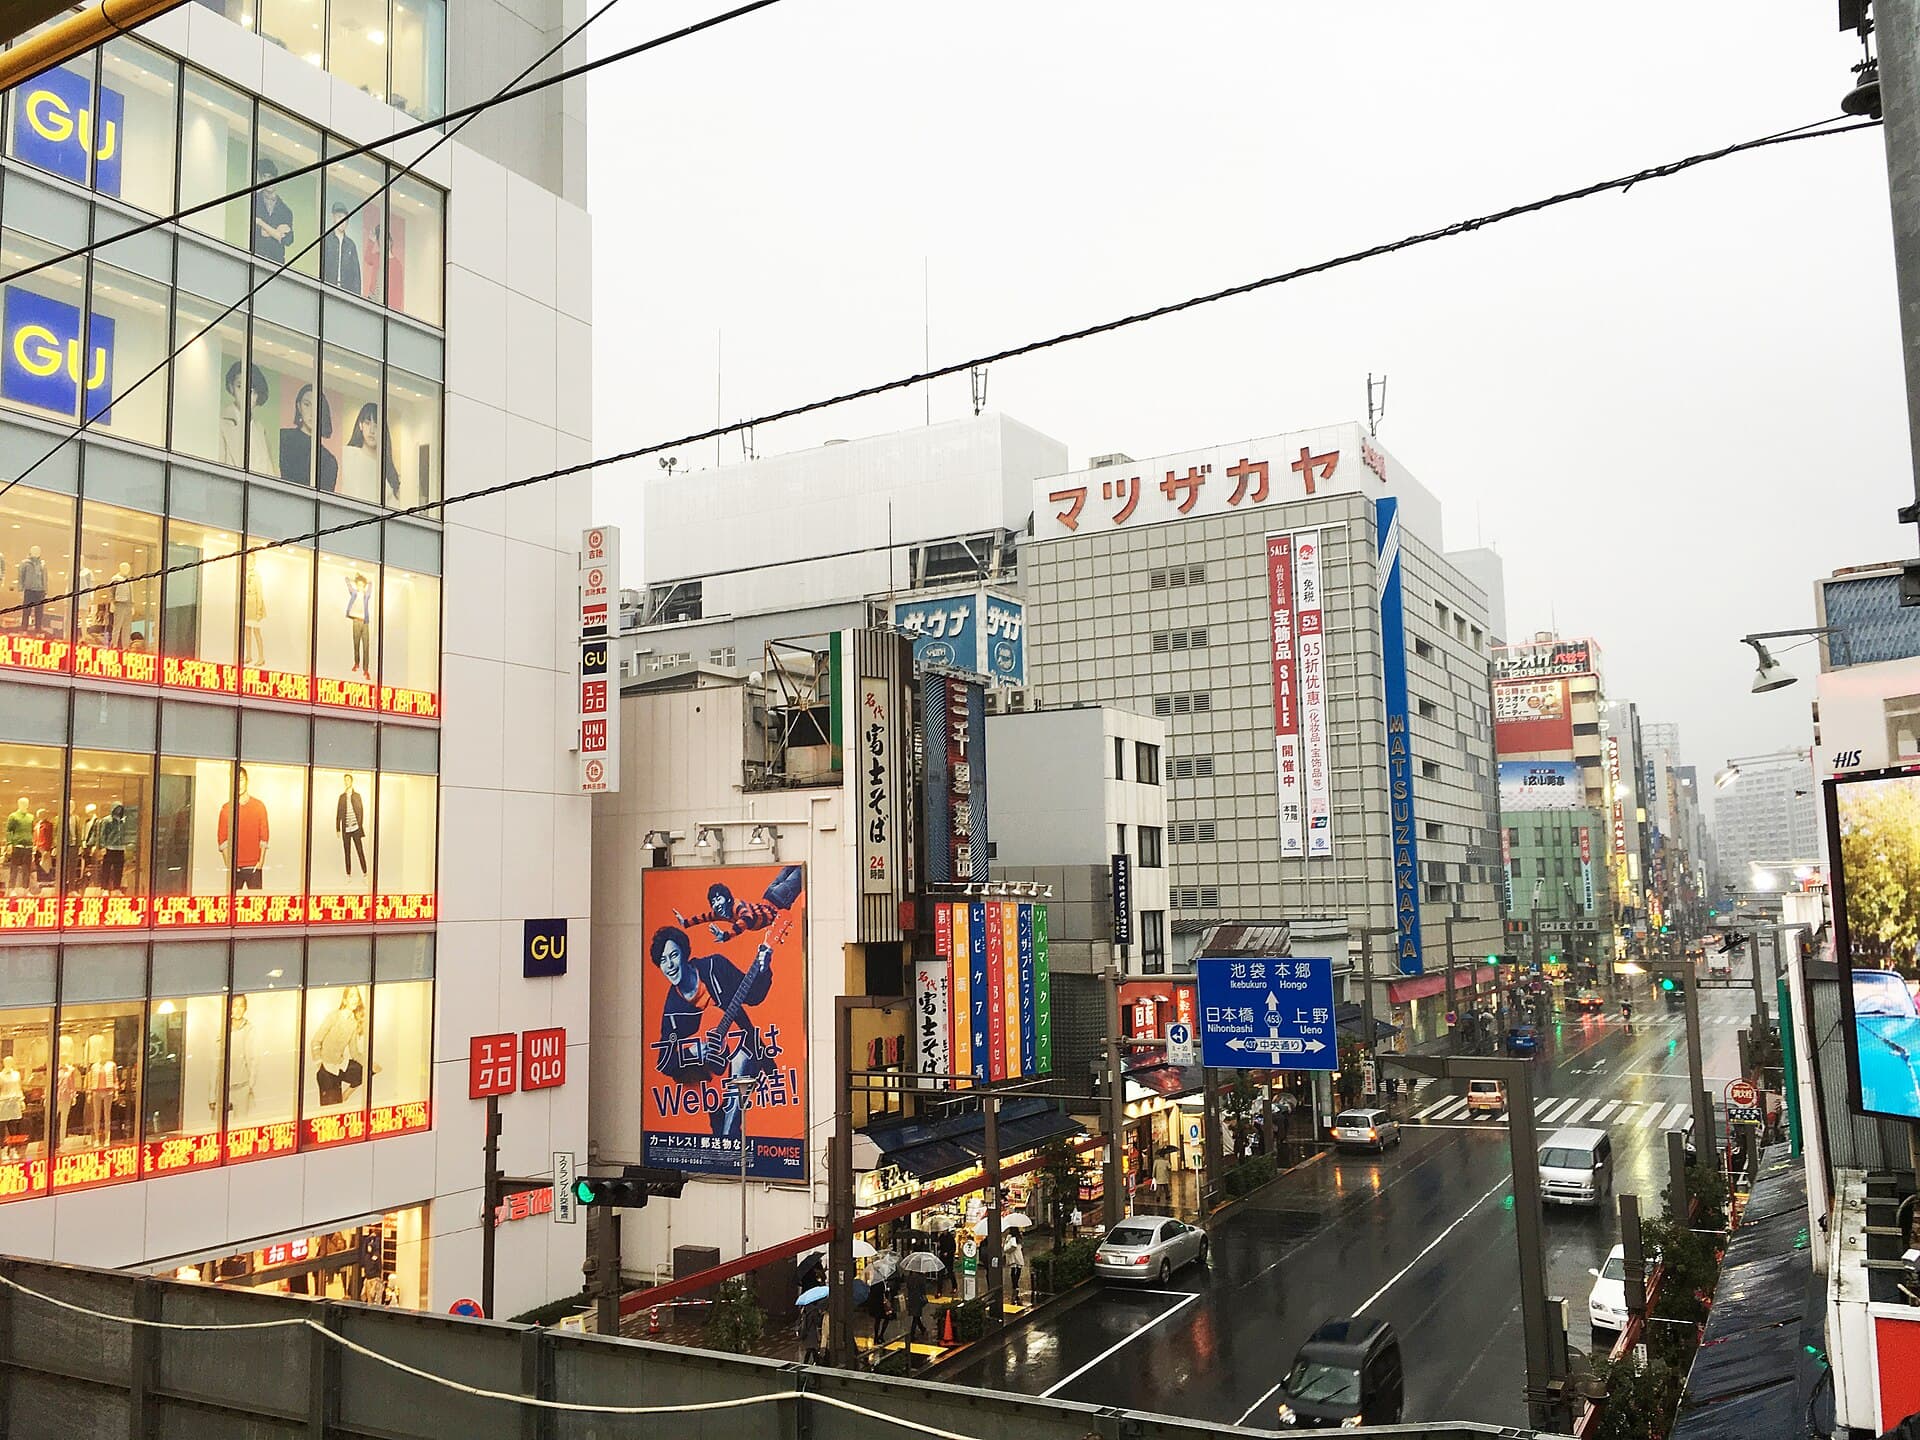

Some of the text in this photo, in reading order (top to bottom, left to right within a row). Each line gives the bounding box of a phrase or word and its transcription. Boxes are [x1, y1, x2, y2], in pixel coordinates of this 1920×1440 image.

[26, 90, 116, 161] GU
[13, 326, 107, 390] GU
[1048, 446, 1340, 532] マツザカヤ
[1270, 545, 1289, 556] SALE
[1303, 579, 1315, 602] 免税
[904, 605, 970, 638] サウナ
[987, 606, 1021, 641] サウナ
[1273, 609, 1292, 661] 宝飾品
[584, 651, 607, 666] GU
[864, 692, 885, 720] 名代
[1280, 665, 1292, 727] SALE
[1281, 745, 1295, 787] 開催中
[1833, 750, 1862, 768] HIS
[865, 723, 889, 844] 富士そば
[1389, 714, 1418, 958] MATSUZAKAYA
[870, 856, 884, 869] 24
[870, 869, 885, 880] 時間
[531, 935, 565, 960] GU
[917, 971, 938, 991] 名代
[1230, 963, 1311, 979] 池袋 本郷
[1036, 909, 1048, 1069] ソルマックプラス
[1230, 981, 1308, 990] Ikebukuro Hongo
[1206, 1007, 1255, 1023] 日本橋
[1266, 1015, 1280, 1024] 453
[1292, 1008, 1329, 1024] 上野
[918, 992, 942, 1075] 富士そば
[1207, 1024, 1253, 1033] Nihonbashi
[1300, 1026, 1323, 1035] Ueno
[531, 1036, 559, 1058] UNI
[650, 1023, 783, 1073] プロミスは
[1260, 1040, 1300, 1050] 中央通り
[530, 1059, 561, 1085] QLO
[652, 1068, 800, 1118] Web完結!
[650, 1135, 697, 1148] カードレス!
[757, 1145, 801, 1159] PROMISE
[783, 1158, 801, 1166] プロミス
[559, 1155, 569, 1219] スクランブル交差点
